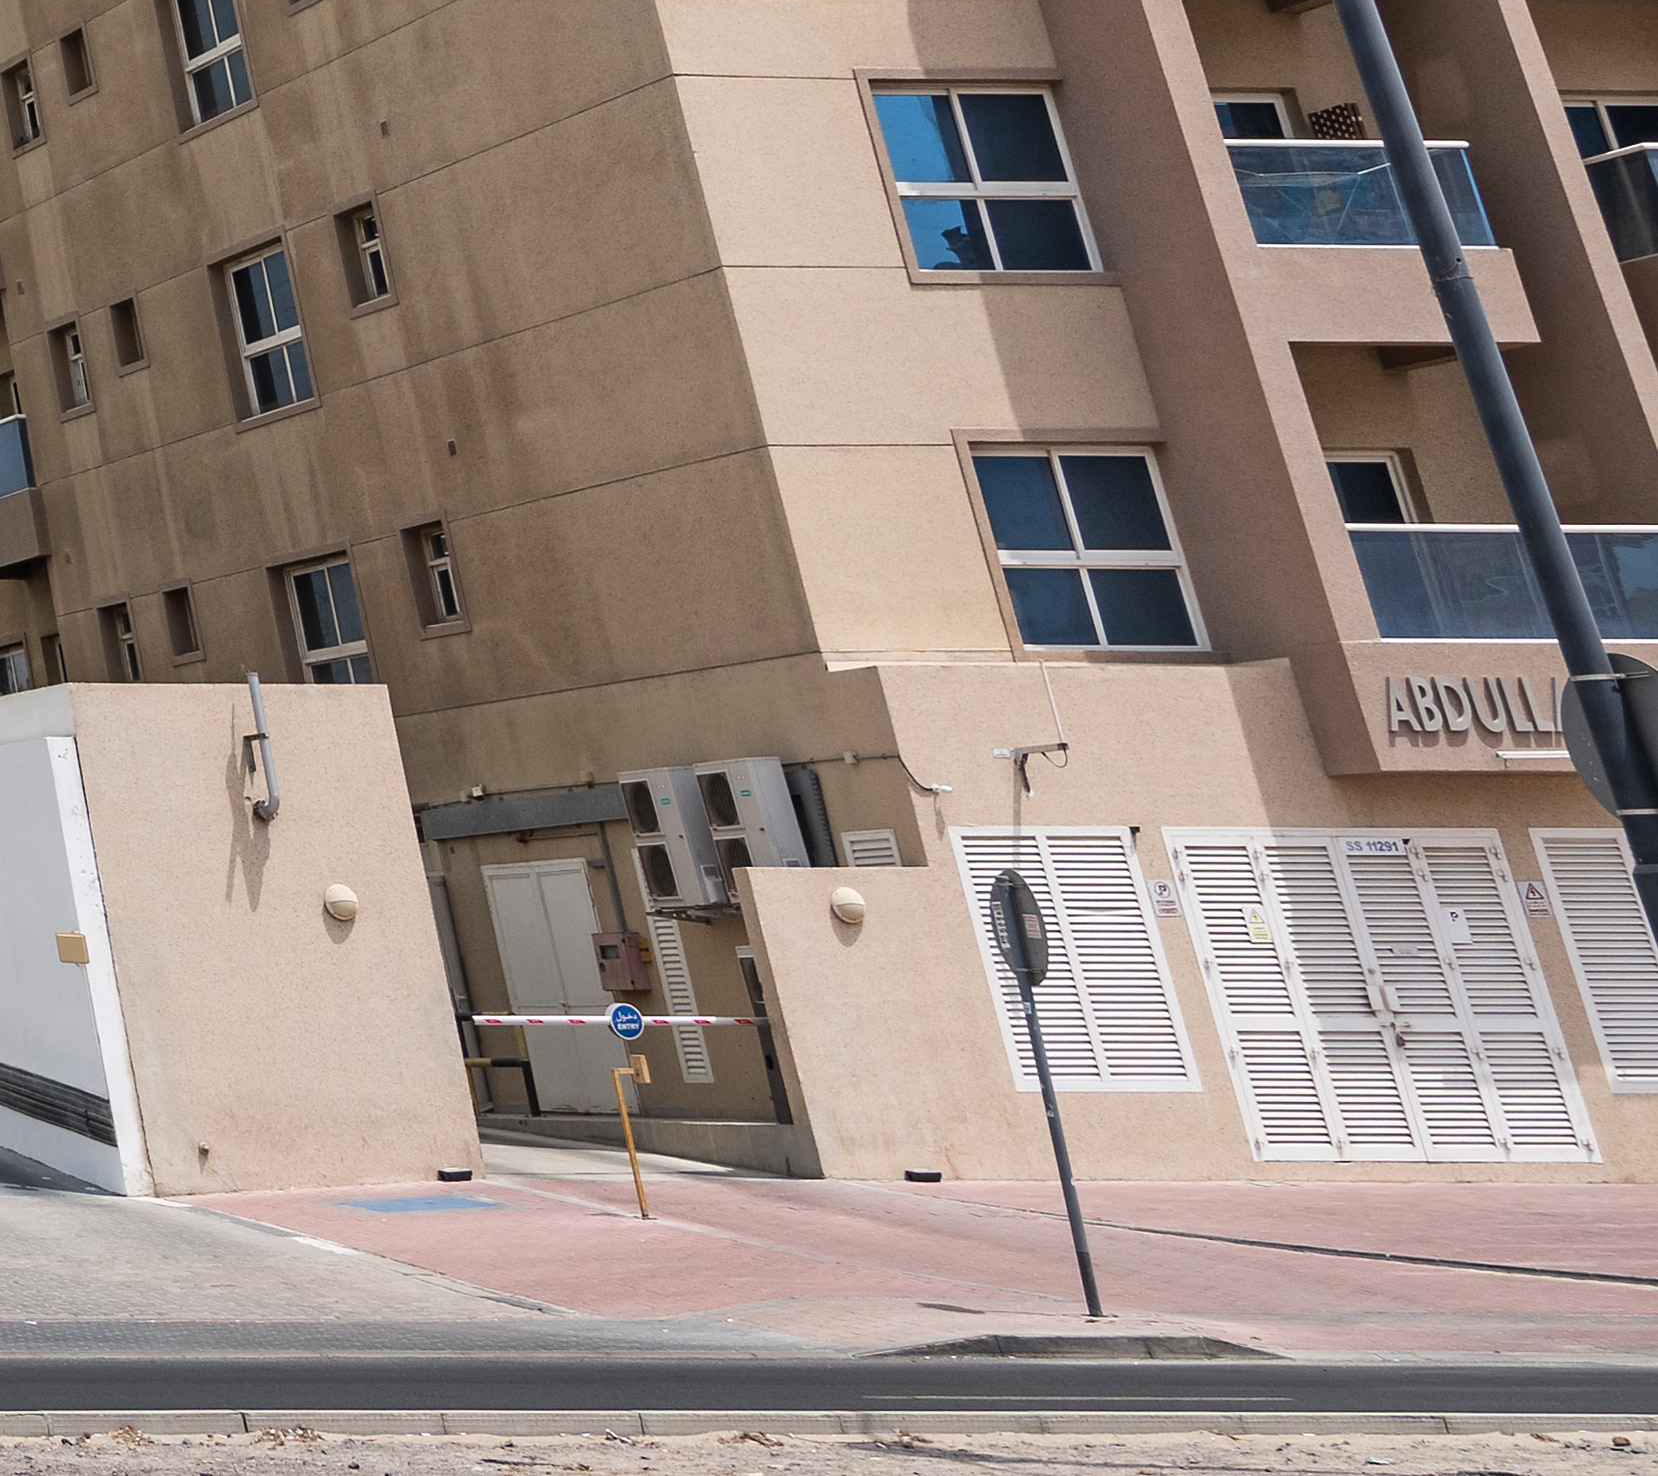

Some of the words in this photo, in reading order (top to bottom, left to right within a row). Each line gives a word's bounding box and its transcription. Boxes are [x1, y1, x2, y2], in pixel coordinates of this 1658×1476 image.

[1385, 676, 1563, 733] ABDULL
[1346, 840, 1363, 852] SS
[1366, 840, 1399, 852] 11291
